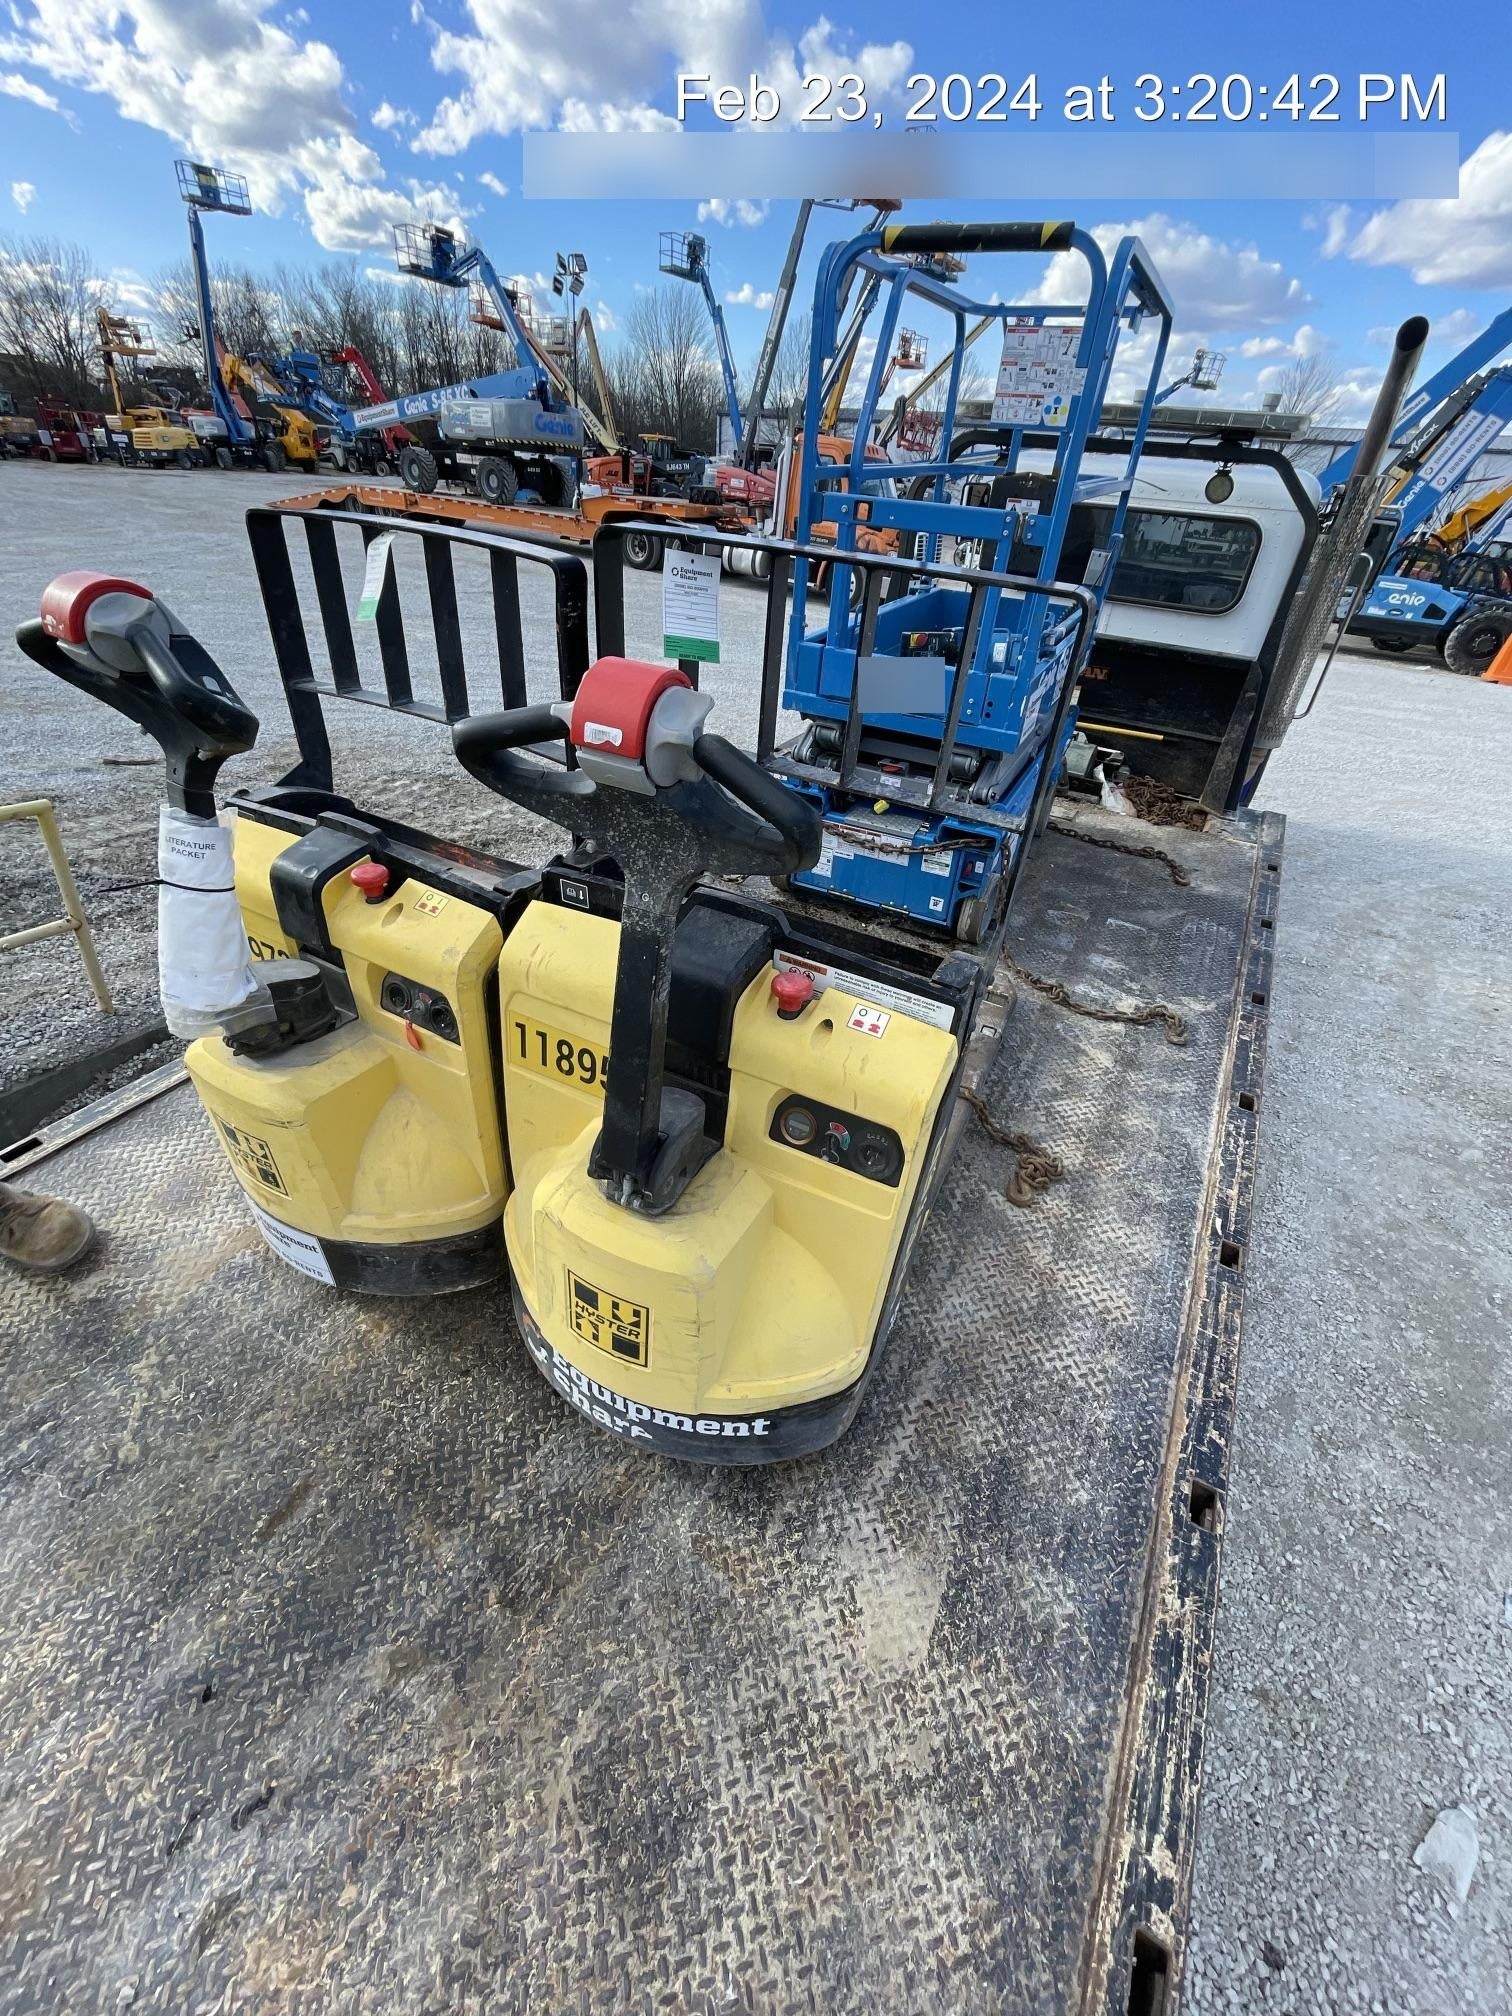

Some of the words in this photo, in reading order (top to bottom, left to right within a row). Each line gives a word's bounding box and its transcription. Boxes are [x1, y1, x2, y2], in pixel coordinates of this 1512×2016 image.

[404, 397, 428, 415] Genie
[534, 413, 576, 436] Genie
[1398, 480, 1426, 508] Genie
[679, 567, 713, 578] Equipment
[679, 573, 698, 581] Share
[166, 835, 216, 851] LITERATURE
[171, 847, 206, 860] PACKET
[575, 1300, 641, 1340] HYSTER
[552, 1350, 771, 1437] Equipment
[552, 1366, 653, 1440] Share
